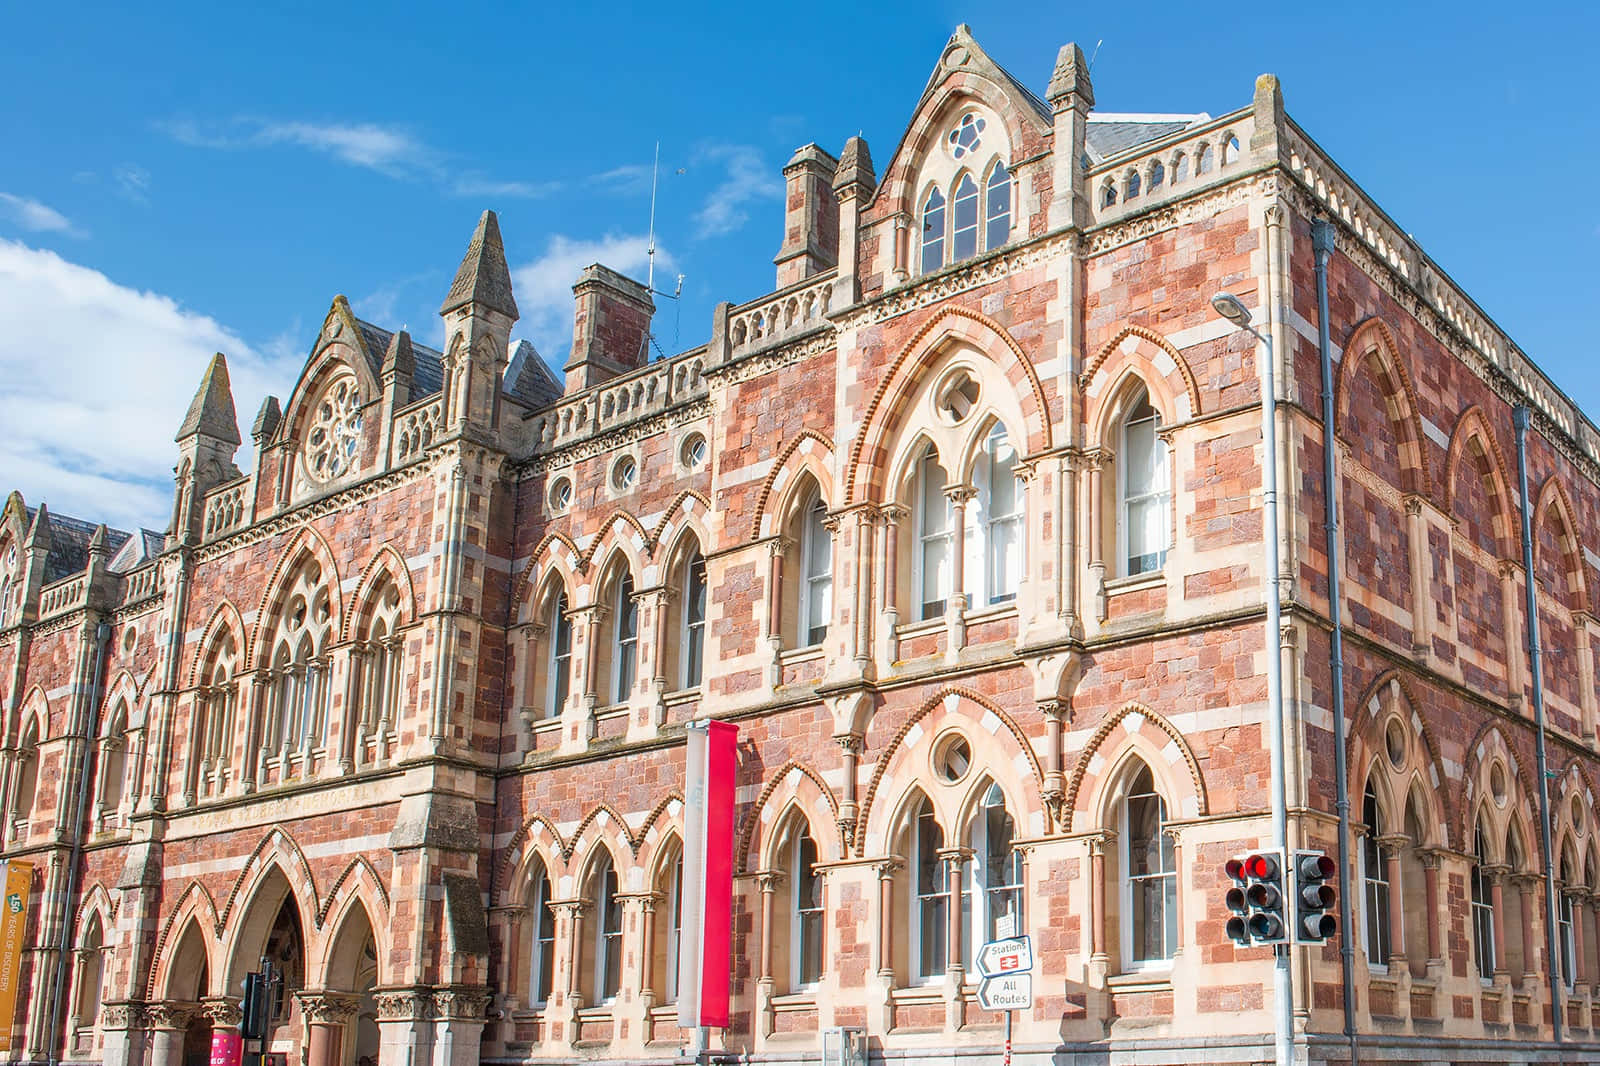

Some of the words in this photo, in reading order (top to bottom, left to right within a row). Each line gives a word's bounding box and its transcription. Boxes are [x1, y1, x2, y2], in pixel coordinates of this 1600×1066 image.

[11, 895, 20, 913] 150
[8, 915, 17, 939] YEARS
[7, 941, 14, 952] OF
[992, 943, 1026, 955] Stations
[1003, 981, 1017, 991] All
[993, 994, 1027, 1005] Routes
